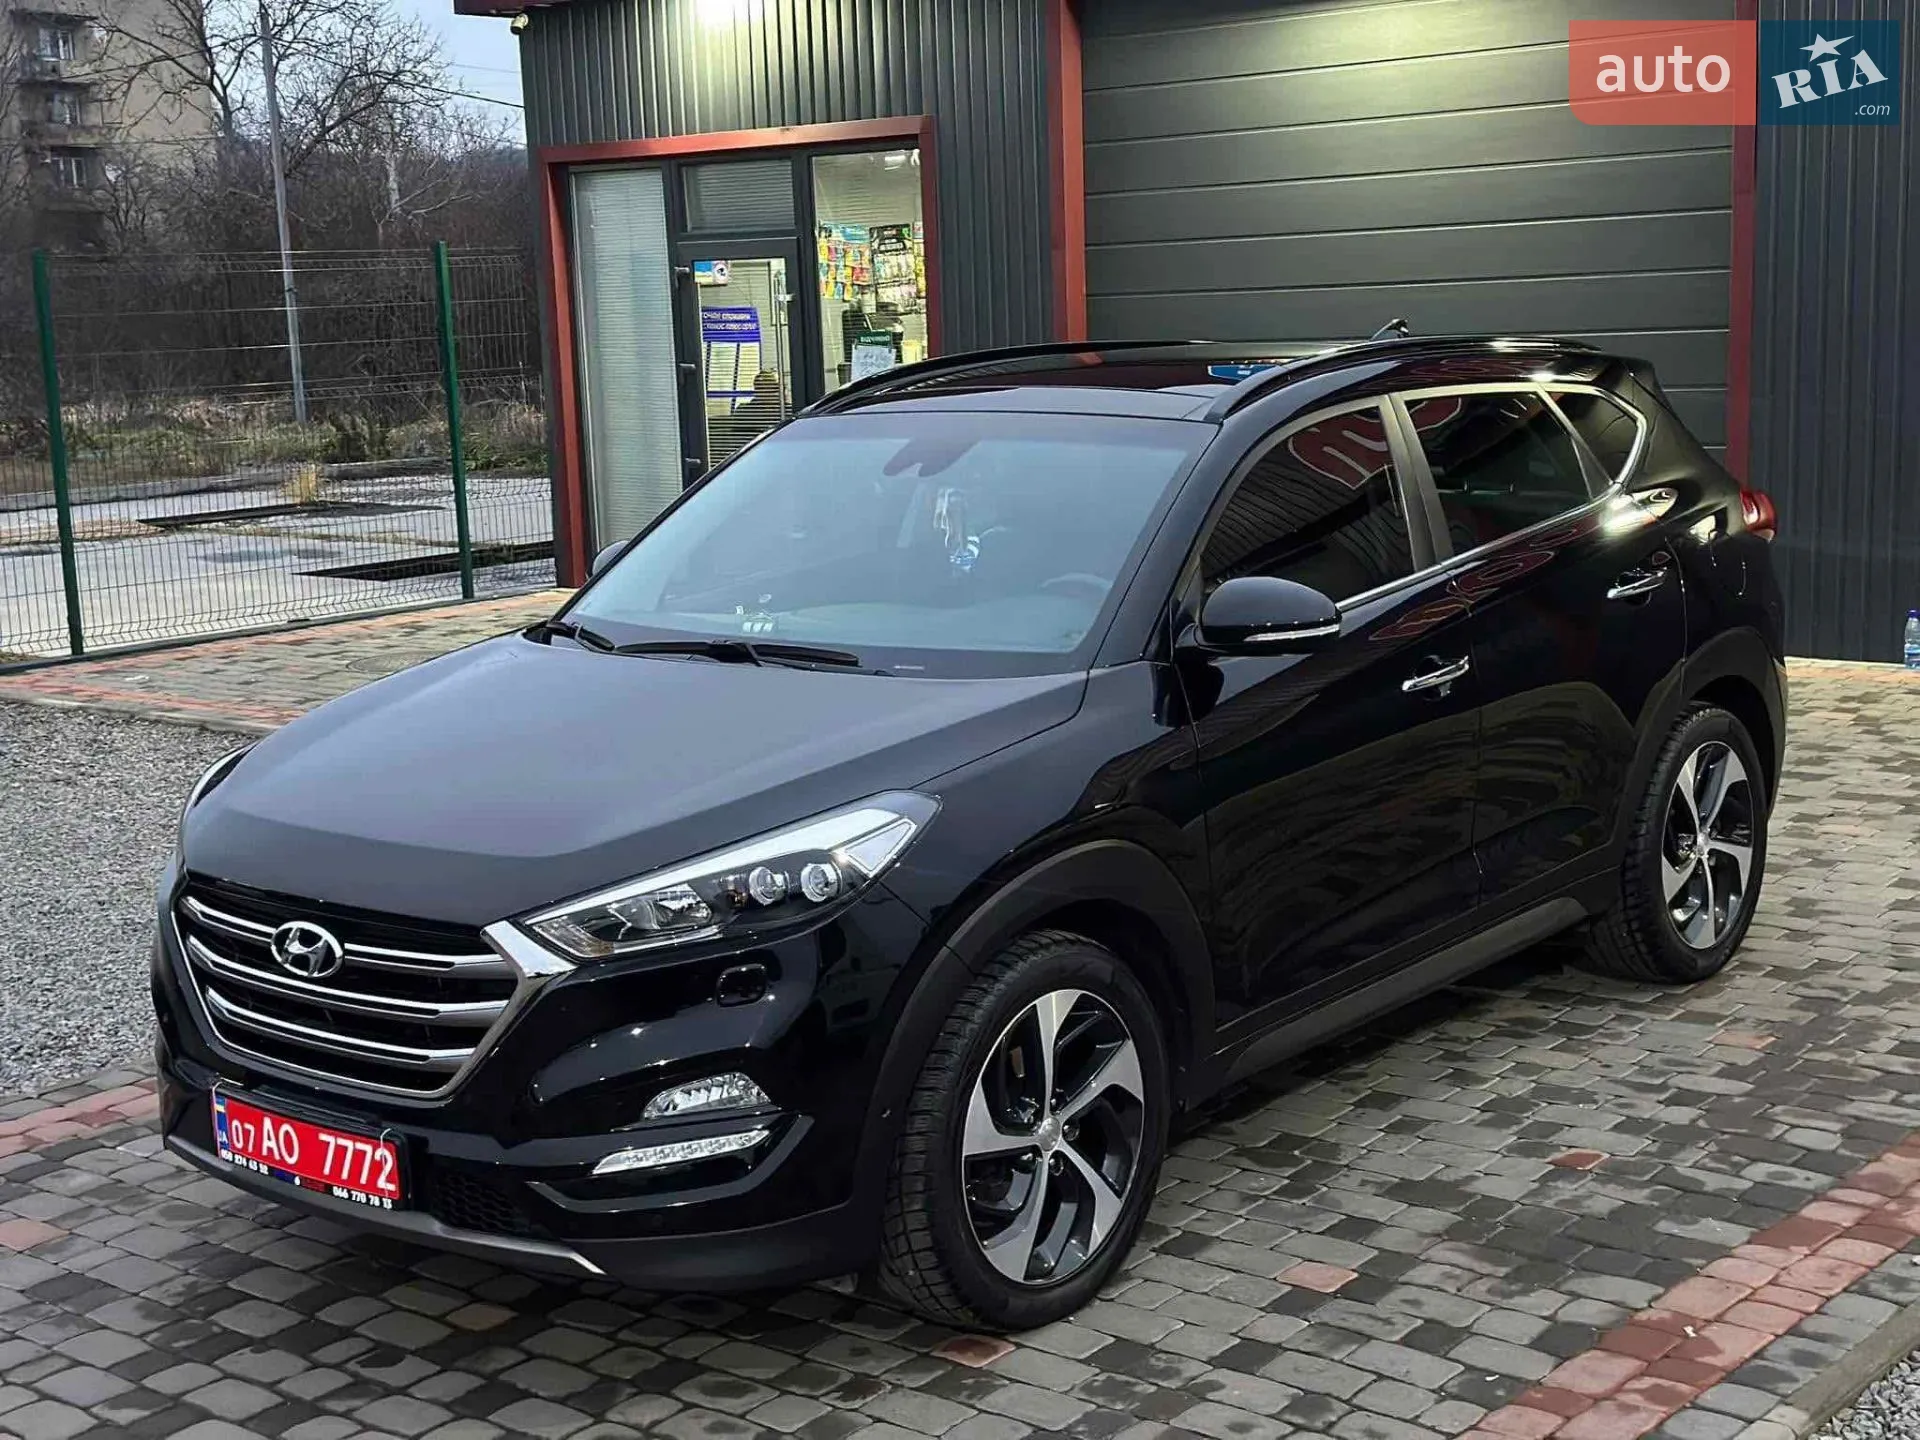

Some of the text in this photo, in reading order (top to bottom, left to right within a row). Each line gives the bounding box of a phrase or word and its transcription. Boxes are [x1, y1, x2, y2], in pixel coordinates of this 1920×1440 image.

[231, 1116, 397, 1192] 07 AO 7772
